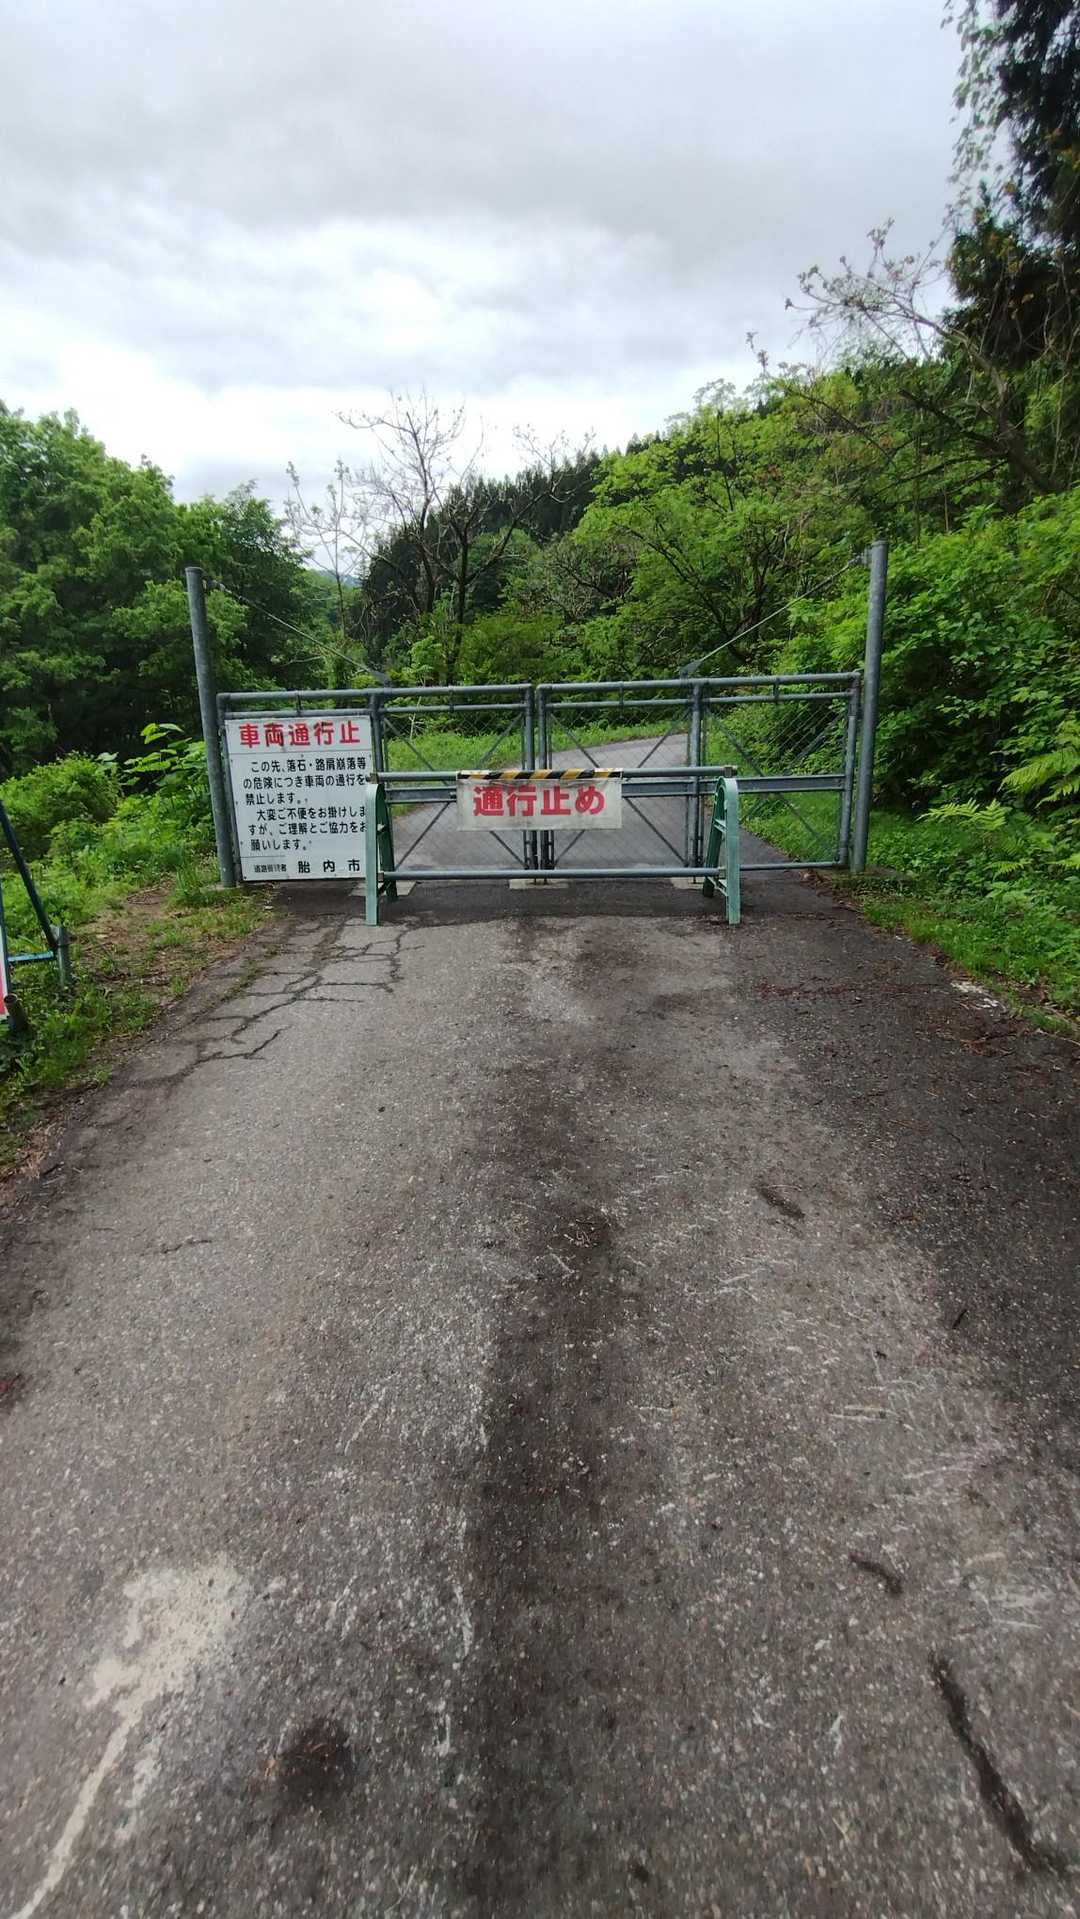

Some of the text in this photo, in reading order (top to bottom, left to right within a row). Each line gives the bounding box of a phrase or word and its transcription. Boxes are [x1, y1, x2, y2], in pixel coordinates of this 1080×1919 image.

[239, 720, 361, 748] 車両通行止
[243, 775, 366, 790] の危険につき車両の通行を
[246, 792, 301, 806] 禁止します。
[473, 784, 605, 816] 通行止め
[257, 807, 365, 821] 大変ご不便をお掛けしま
[251, 839, 307, 851] 願いします。
